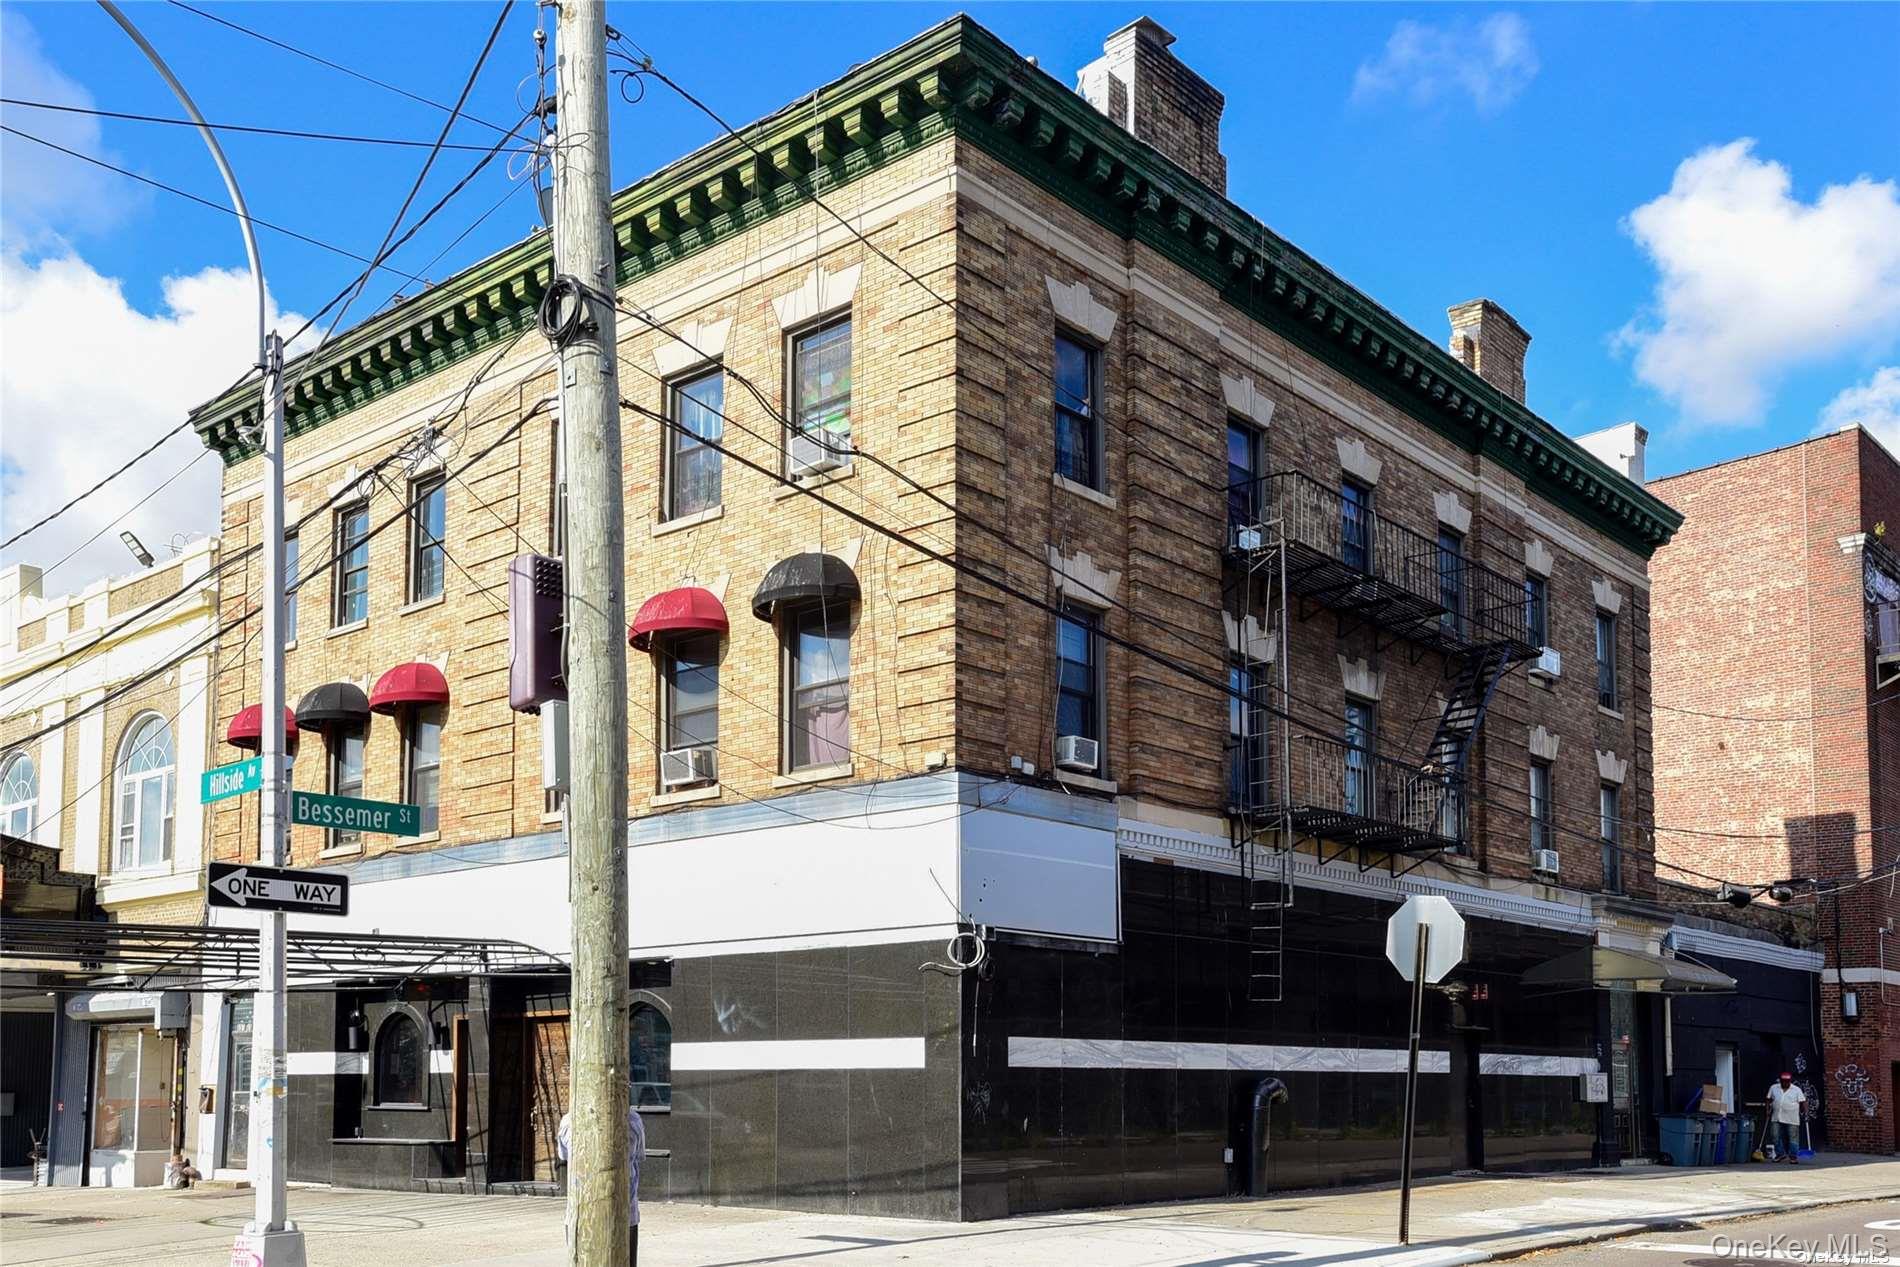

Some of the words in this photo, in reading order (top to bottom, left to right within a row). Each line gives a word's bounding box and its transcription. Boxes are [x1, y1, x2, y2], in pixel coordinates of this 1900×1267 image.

[209, 768, 244, 797] Hillside
[247, 763, 256, 777] Av
[298, 797, 391, 829] Bessemer
[399, 808, 411, 824] St
[228, 878, 270, 897] ONE
[294, 883, 337, 902] WAY
